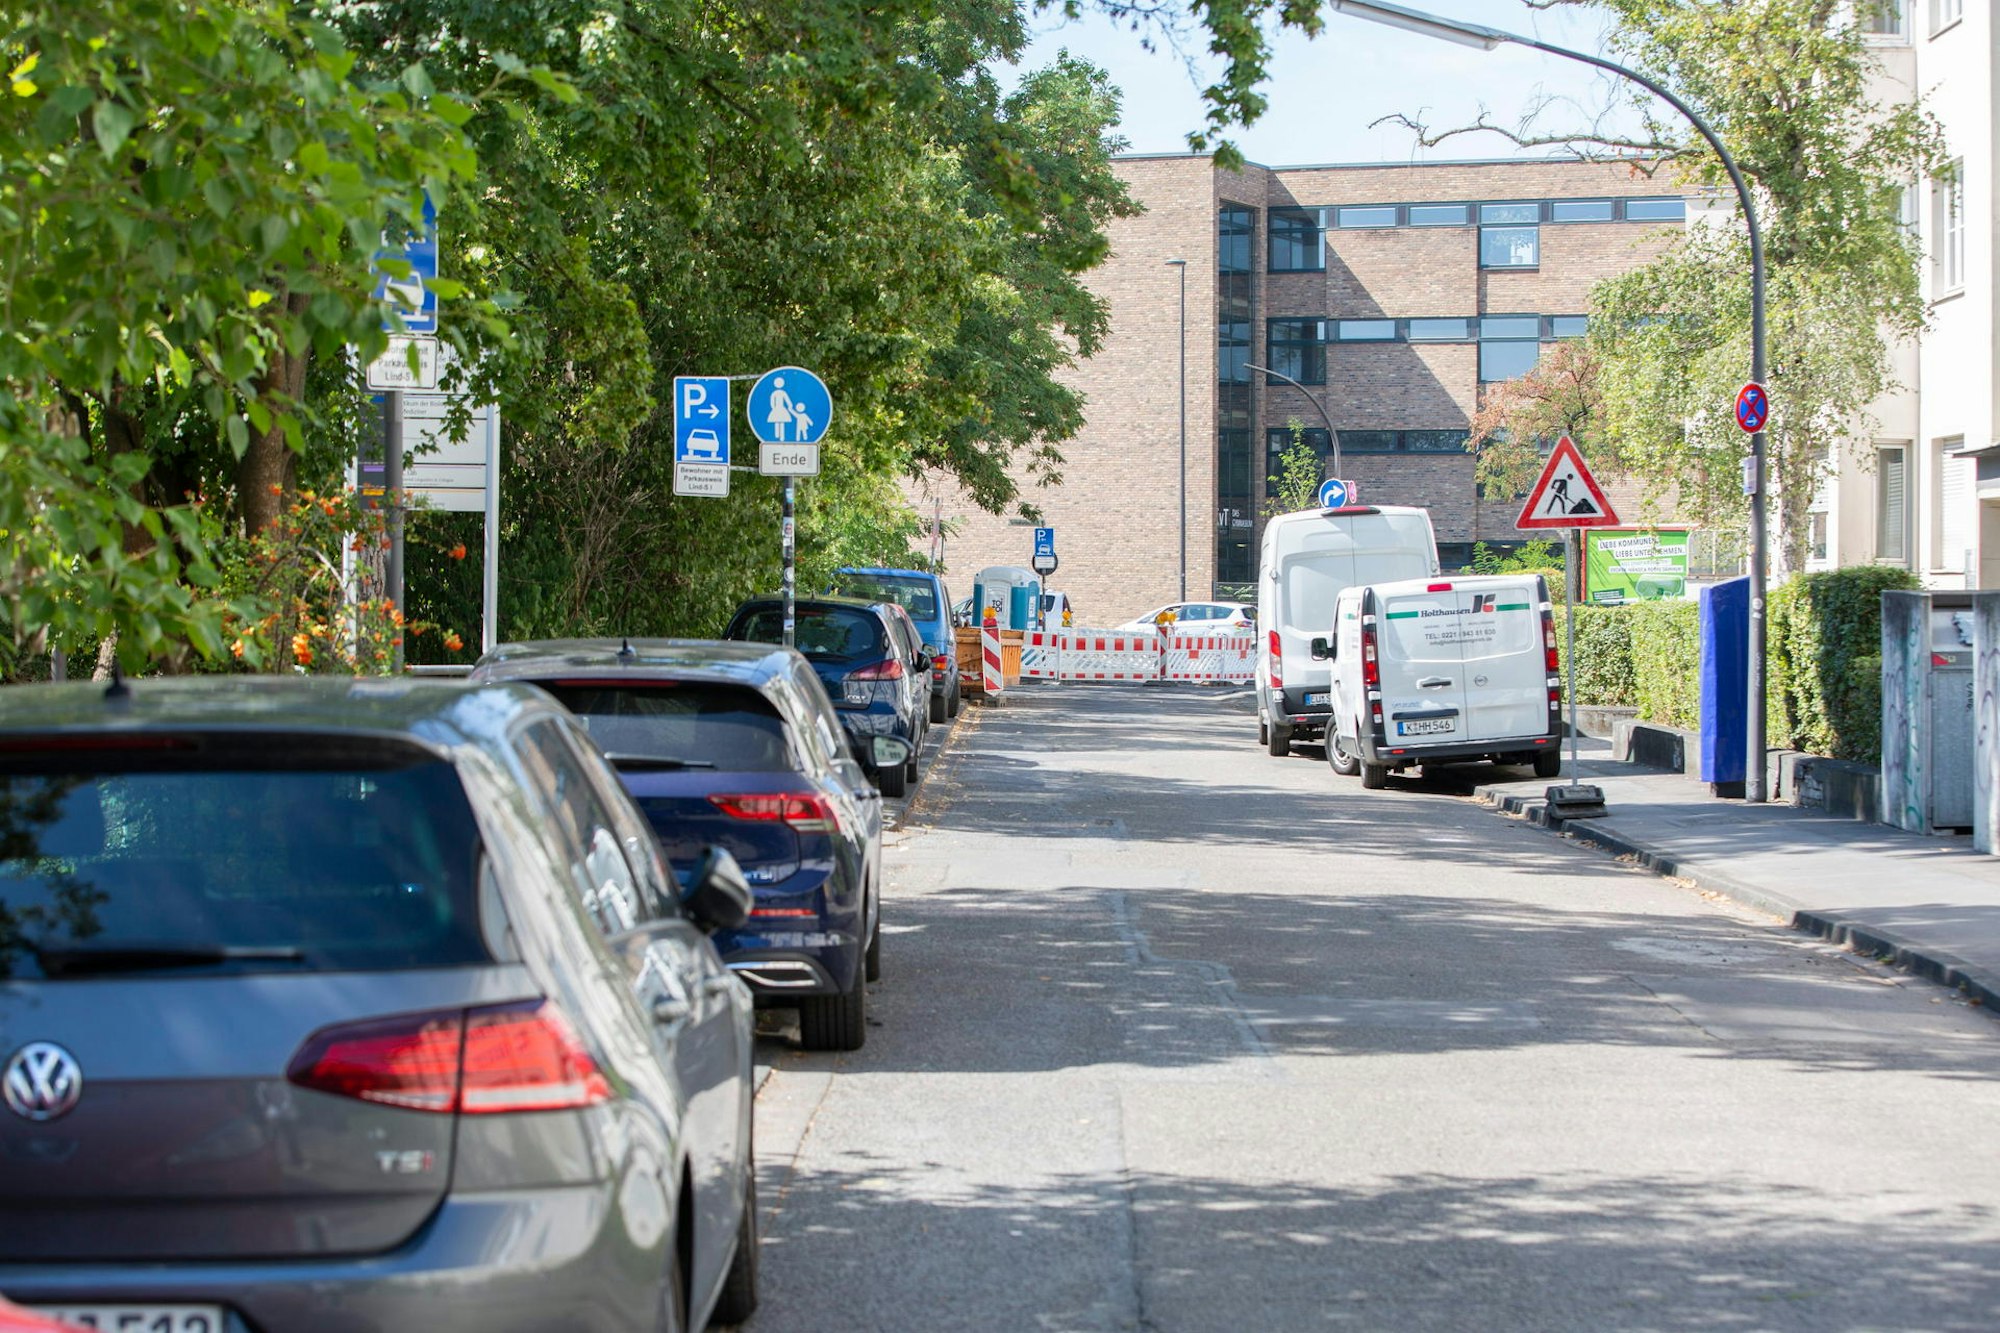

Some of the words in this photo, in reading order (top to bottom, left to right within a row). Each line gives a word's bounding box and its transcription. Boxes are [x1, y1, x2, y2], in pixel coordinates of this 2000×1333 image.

[378, 358, 428, 369] Parkauis
[683, 383, 707, 419] P
[772, 452, 807, 465] Ende
[683, 475, 723, 483] Parkausweis
[1037, 530, 1046, 541] P
[1615, 549, 1633, 558] LIEBE
[1420, 608, 1471, 618] Holthausen
[1432, 720, 1451, 730] 546
